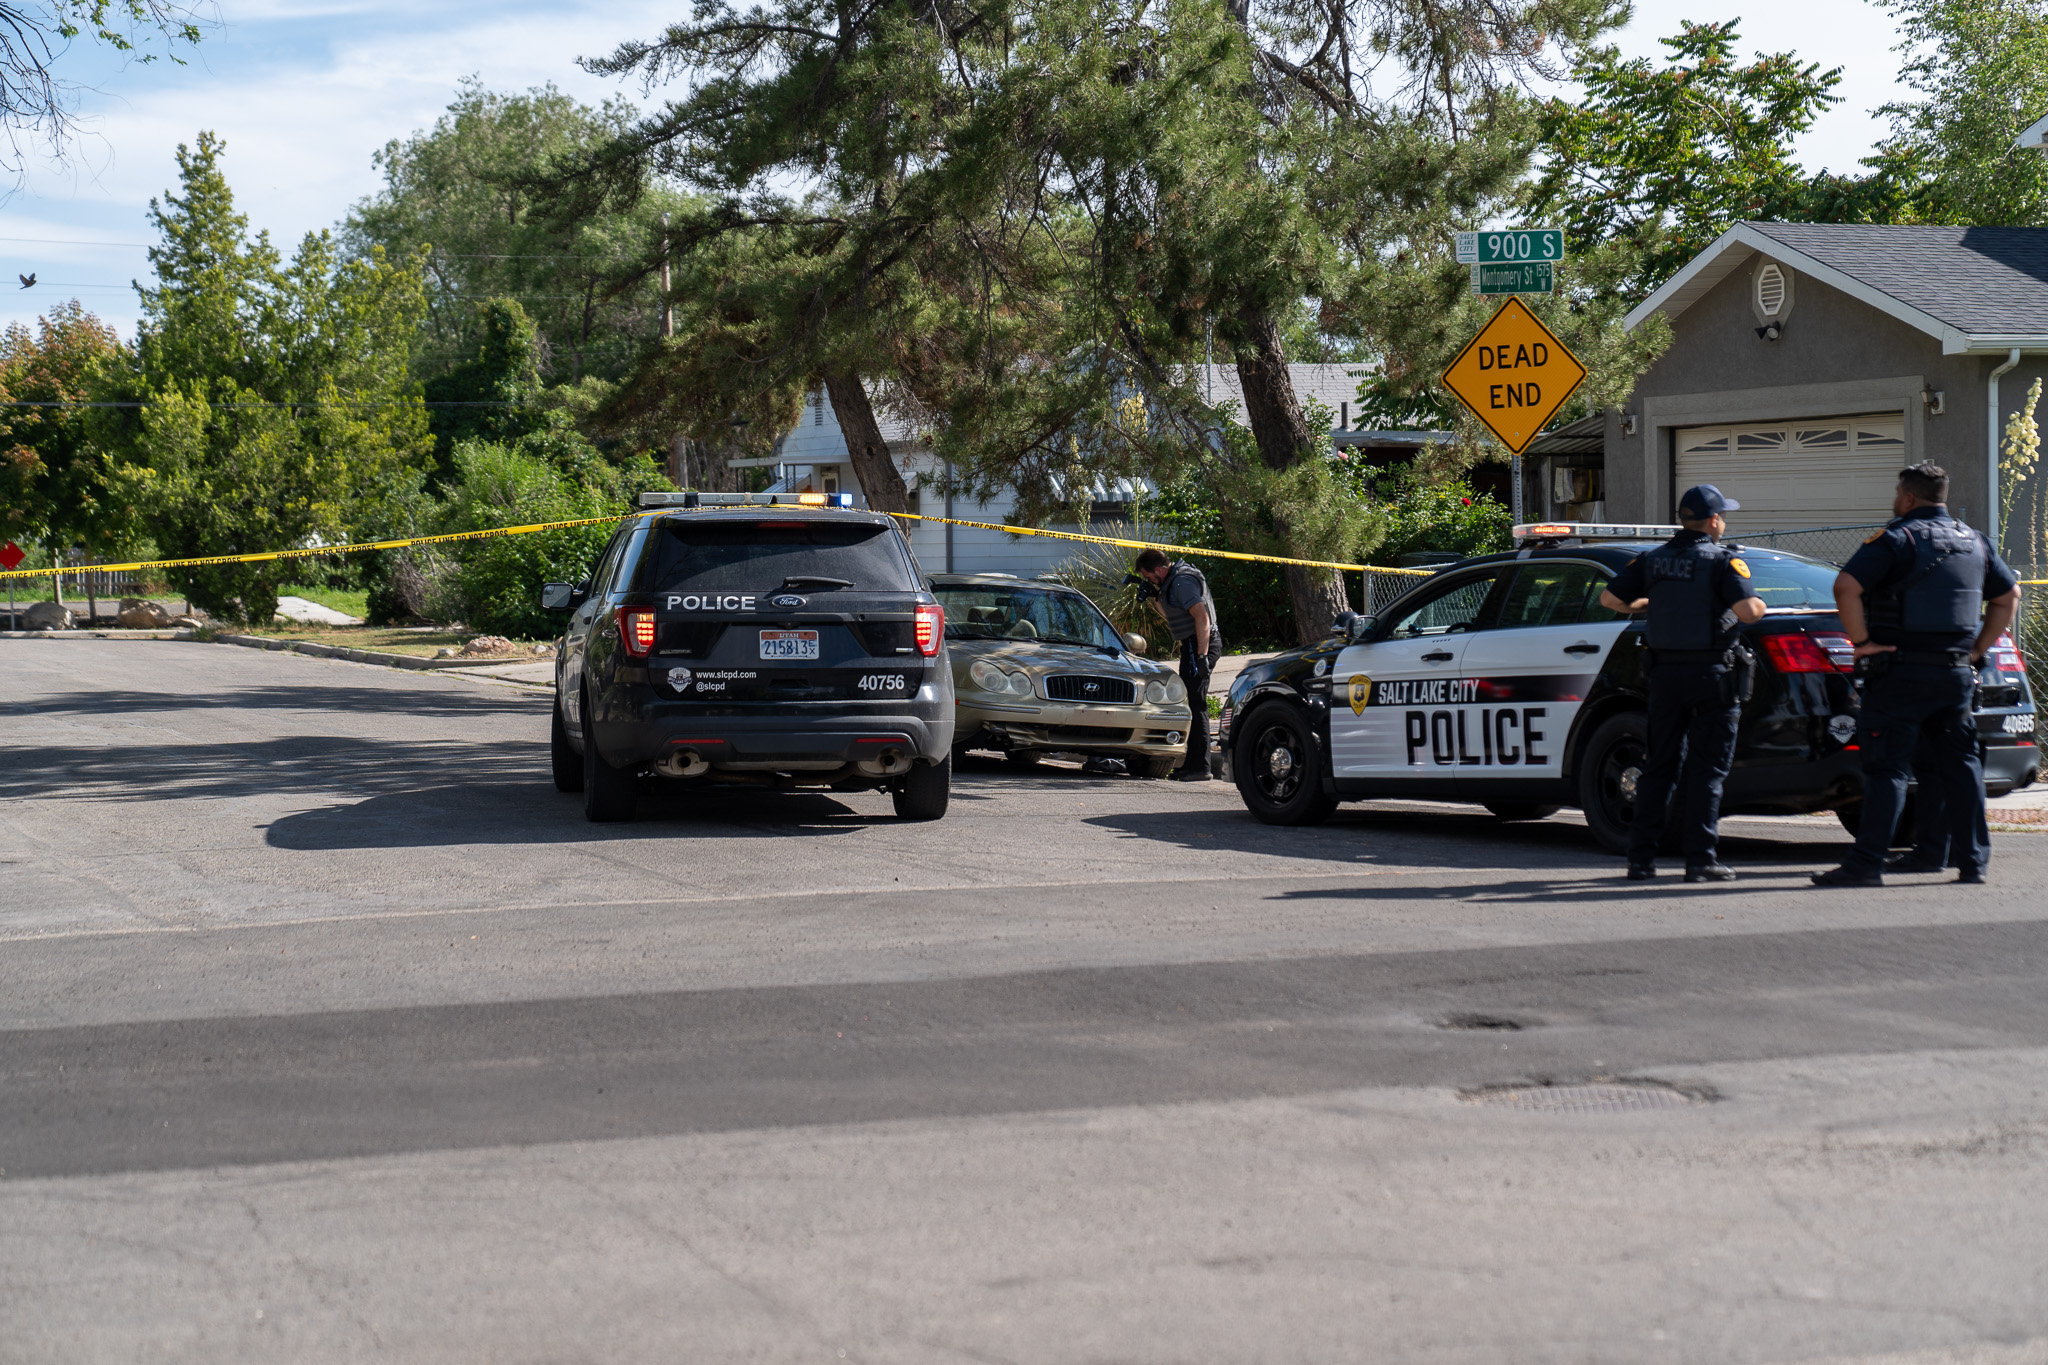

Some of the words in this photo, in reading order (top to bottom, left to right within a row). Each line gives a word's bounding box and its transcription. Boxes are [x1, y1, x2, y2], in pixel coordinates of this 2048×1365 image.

[1488, 234, 1531, 258] 900
[1543, 234, 1554, 257] S
[1482, 268, 1522, 291] Montgomery
[1524, 266, 1533, 285] St
[1536, 264, 1550, 277] 1575
[1541, 278, 1546, 290] W
[1479, 343, 1548, 370] DEAD
[1490, 383, 1541, 409] END
[485, 530, 508, 538] CROSS
[1654, 558, 1692, 578] POLICE
[667, 596, 756, 610] POLICE
[764, 640, 808, 654] 215813
[696, 670, 756, 680] www.slcpd.com
[858, 674, 904, 690] 40756
[696, 682, 726, 692] @slcpd
[1379, 682, 1409, 704] SALT
[1412, 681, 1446, 703] LAKE
[1450, 679, 1480, 703] CITY
[2002, 714, 2034, 733] 40695
[1406, 708, 1549, 765] POLICE
